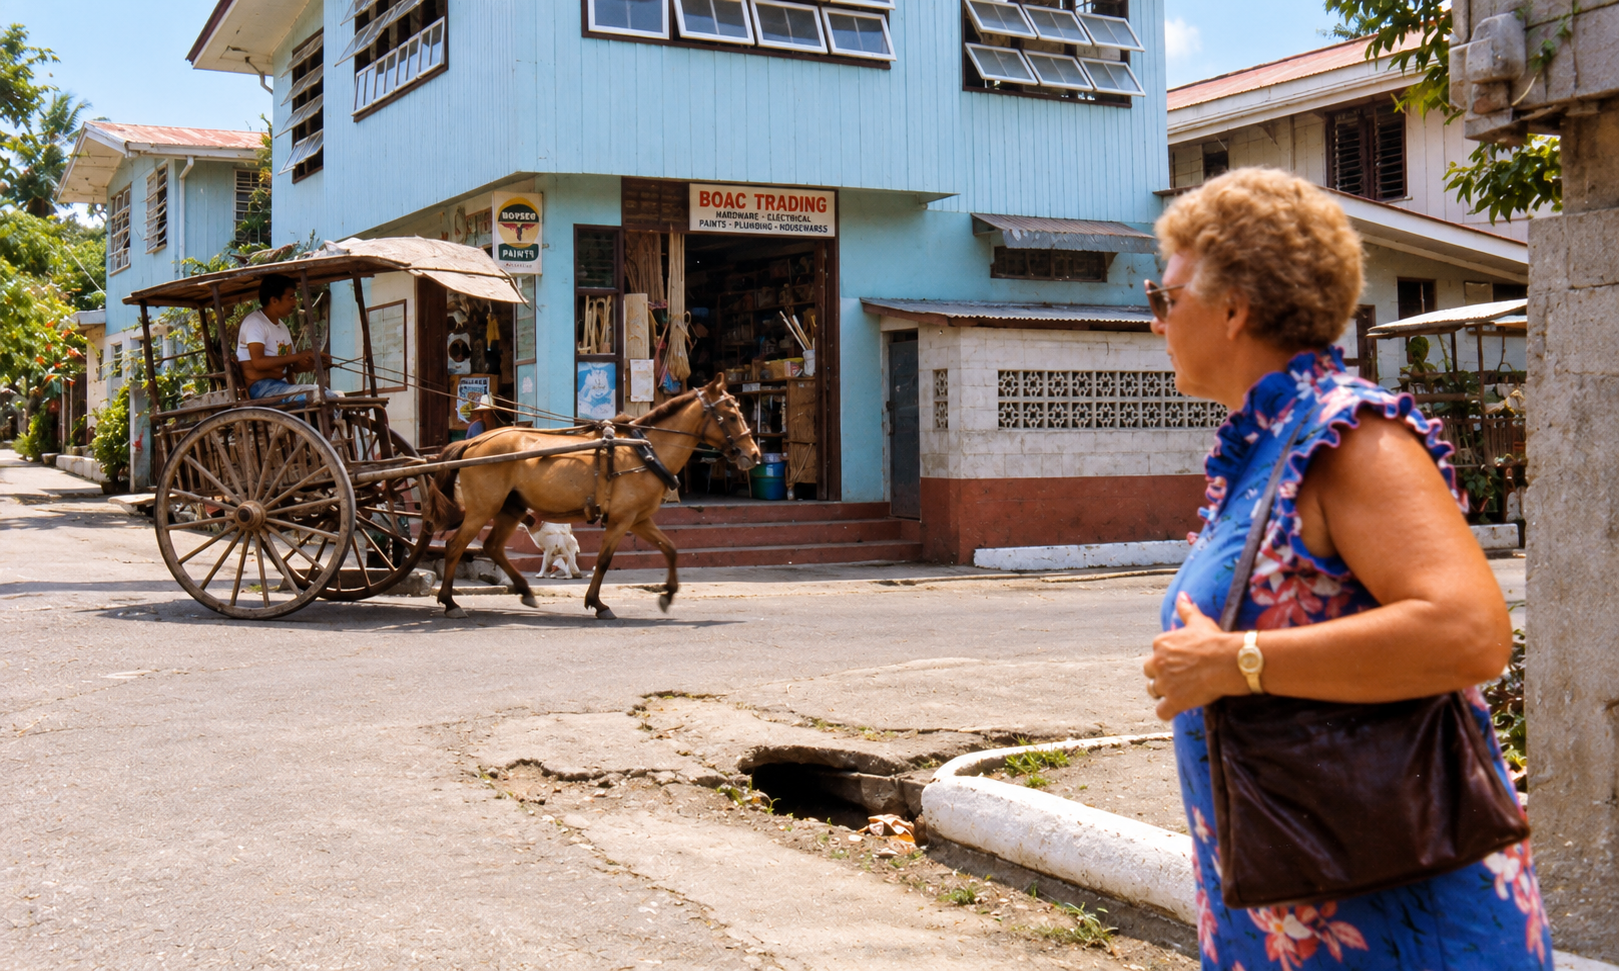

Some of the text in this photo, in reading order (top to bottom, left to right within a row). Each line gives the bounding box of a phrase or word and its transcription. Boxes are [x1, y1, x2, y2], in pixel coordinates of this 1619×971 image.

[699, 190, 827, 213] BOAC TRADING
[715, 211, 759, 220] HARDWARE
[699, 219, 726, 228] PAINTS
